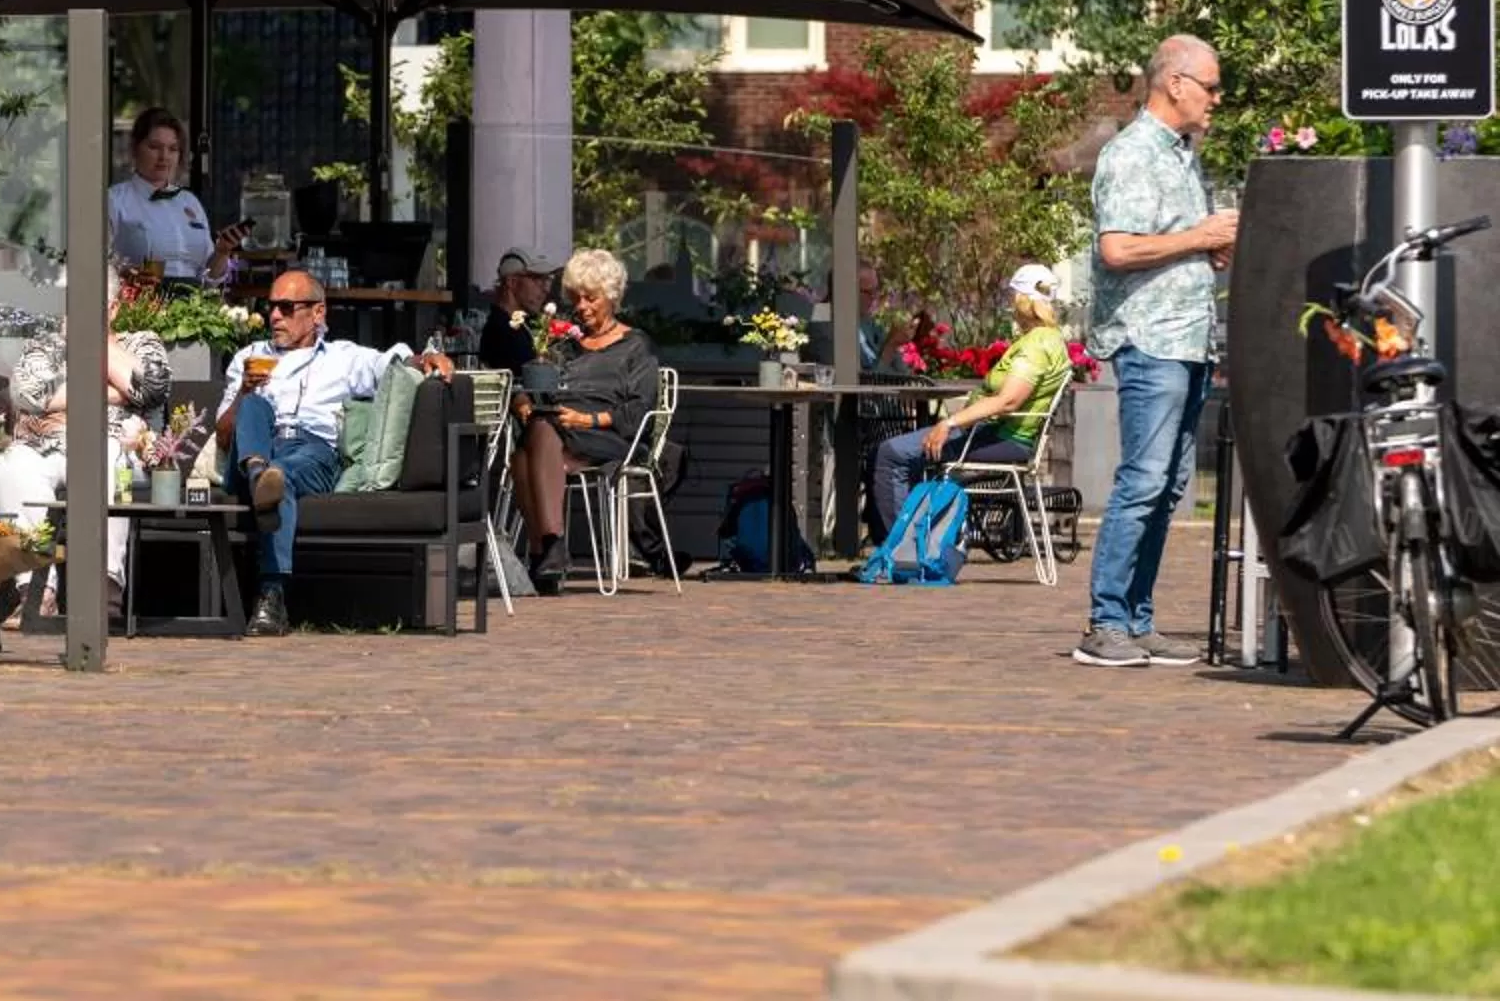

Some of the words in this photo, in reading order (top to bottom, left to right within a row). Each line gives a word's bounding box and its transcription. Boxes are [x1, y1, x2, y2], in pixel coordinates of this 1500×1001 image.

[1390, 74, 1422, 84] ONLY
[1423, 74, 1447, 84] FOR
[1362, 89, 1409, 99] PICK-UP
[1410, 89, 1439, 99] TAKE
[1440, 89, 1476, 99] AWAY
